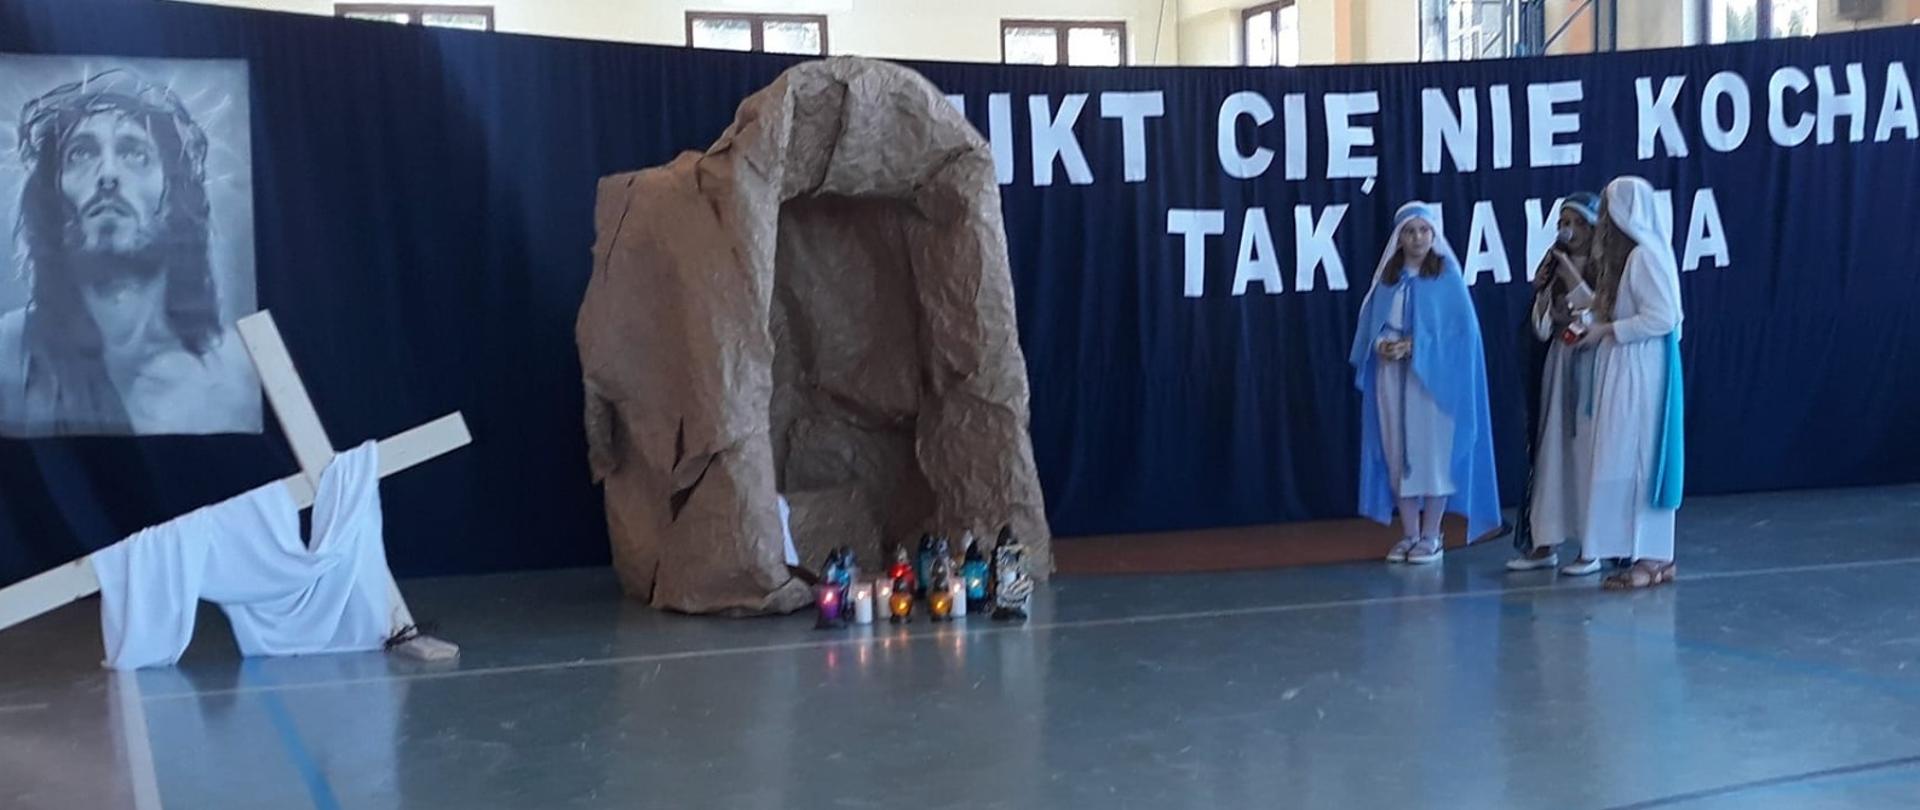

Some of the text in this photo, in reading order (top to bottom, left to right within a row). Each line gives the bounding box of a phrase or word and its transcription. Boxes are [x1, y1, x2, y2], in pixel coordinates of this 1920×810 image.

[945, 62, 1919, 195] IKT CIĘ NIE KOCHA
[1167, 187, 1730, 297] TAK AK A
